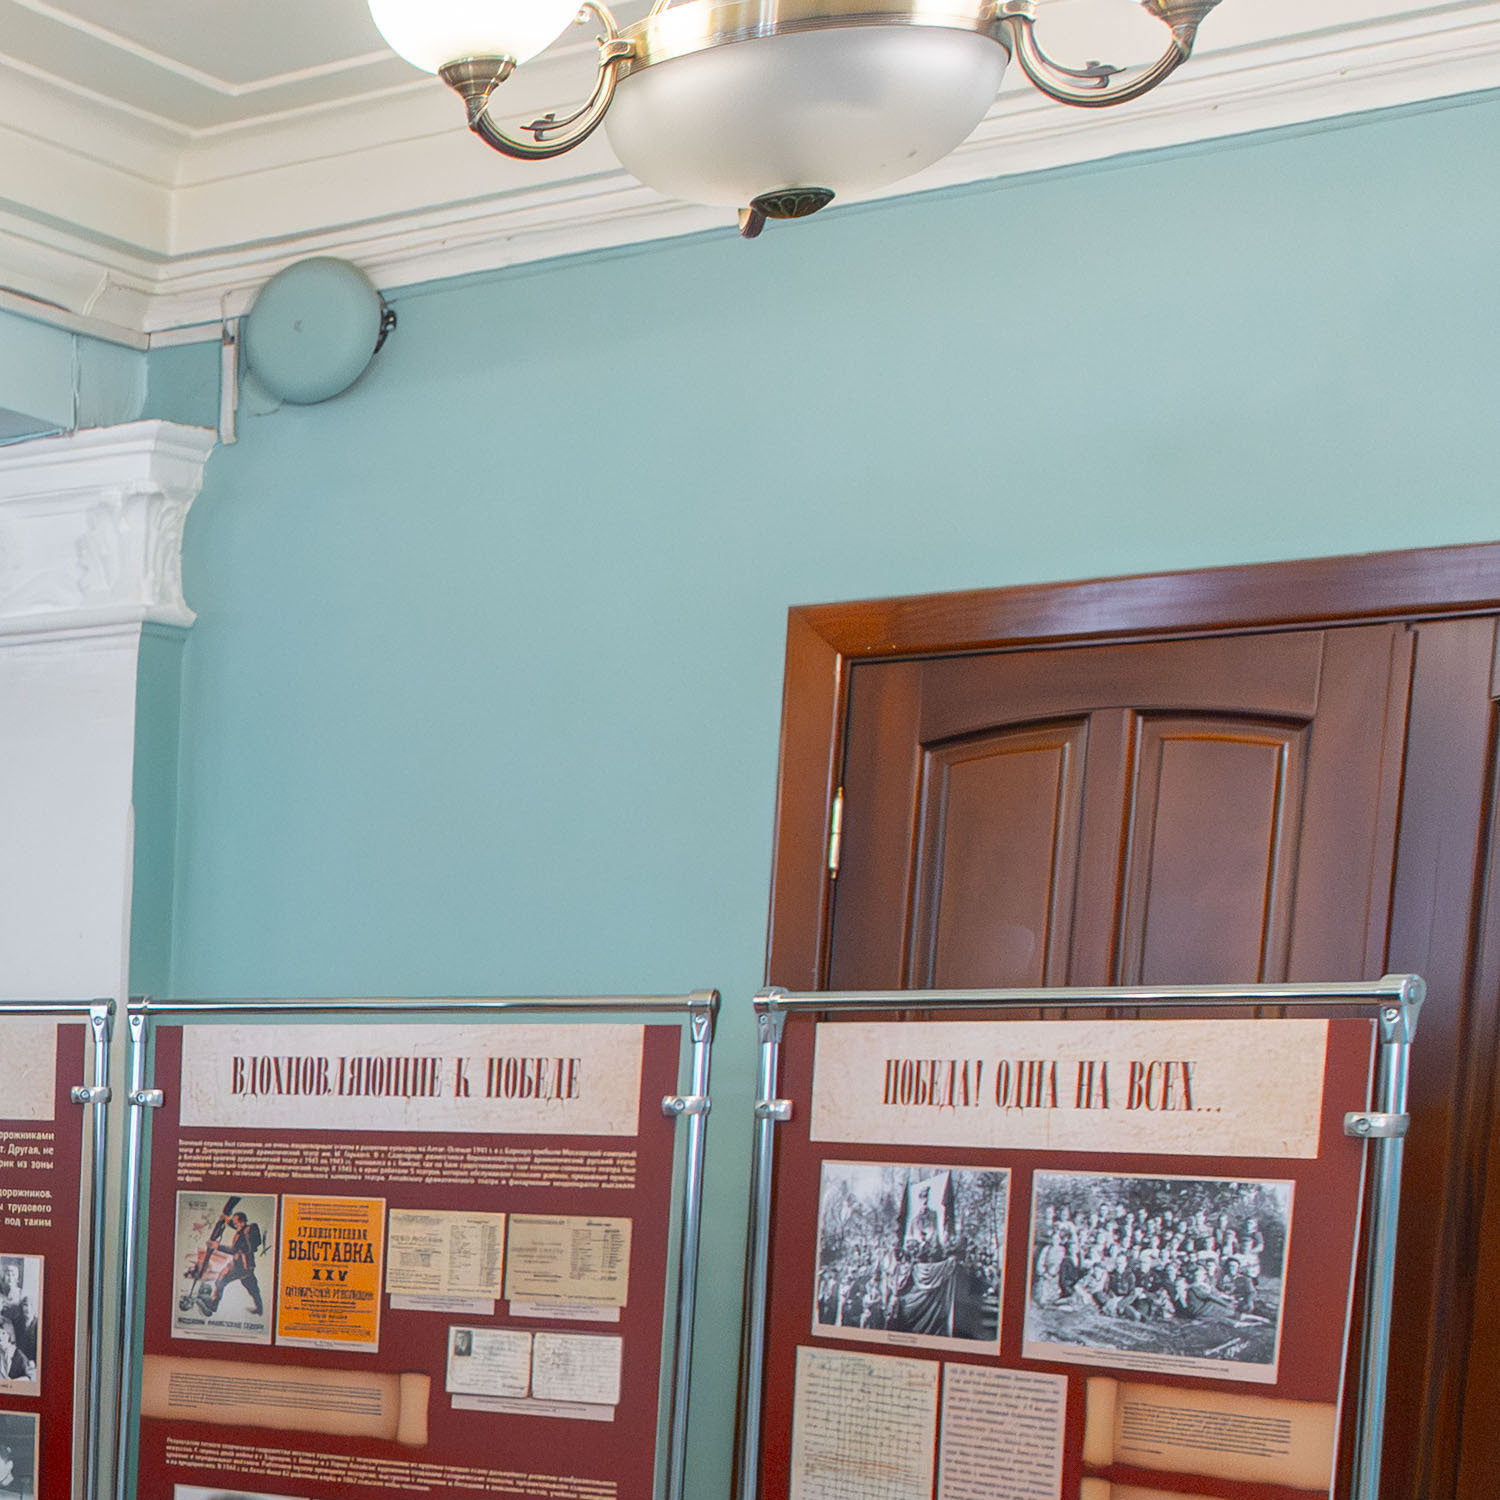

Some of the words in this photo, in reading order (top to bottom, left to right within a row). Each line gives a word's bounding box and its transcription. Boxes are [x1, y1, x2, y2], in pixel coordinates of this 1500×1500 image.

[231, 1055, 443, 1102] ВДОХНОВЛЯЮЩИЕ
[454, 1057, 471, 1098] К
[485, 1057, 582, 1105] ПОБЕДЕ
[883, 1058, 983, 1113] ПОБЕДА!
[995, 1059, 1059, 1115] ОДНА
[1075, 1060, 1110, 1109] НА
[288, 1239, 374, 1263] ВЫСТАВКА
